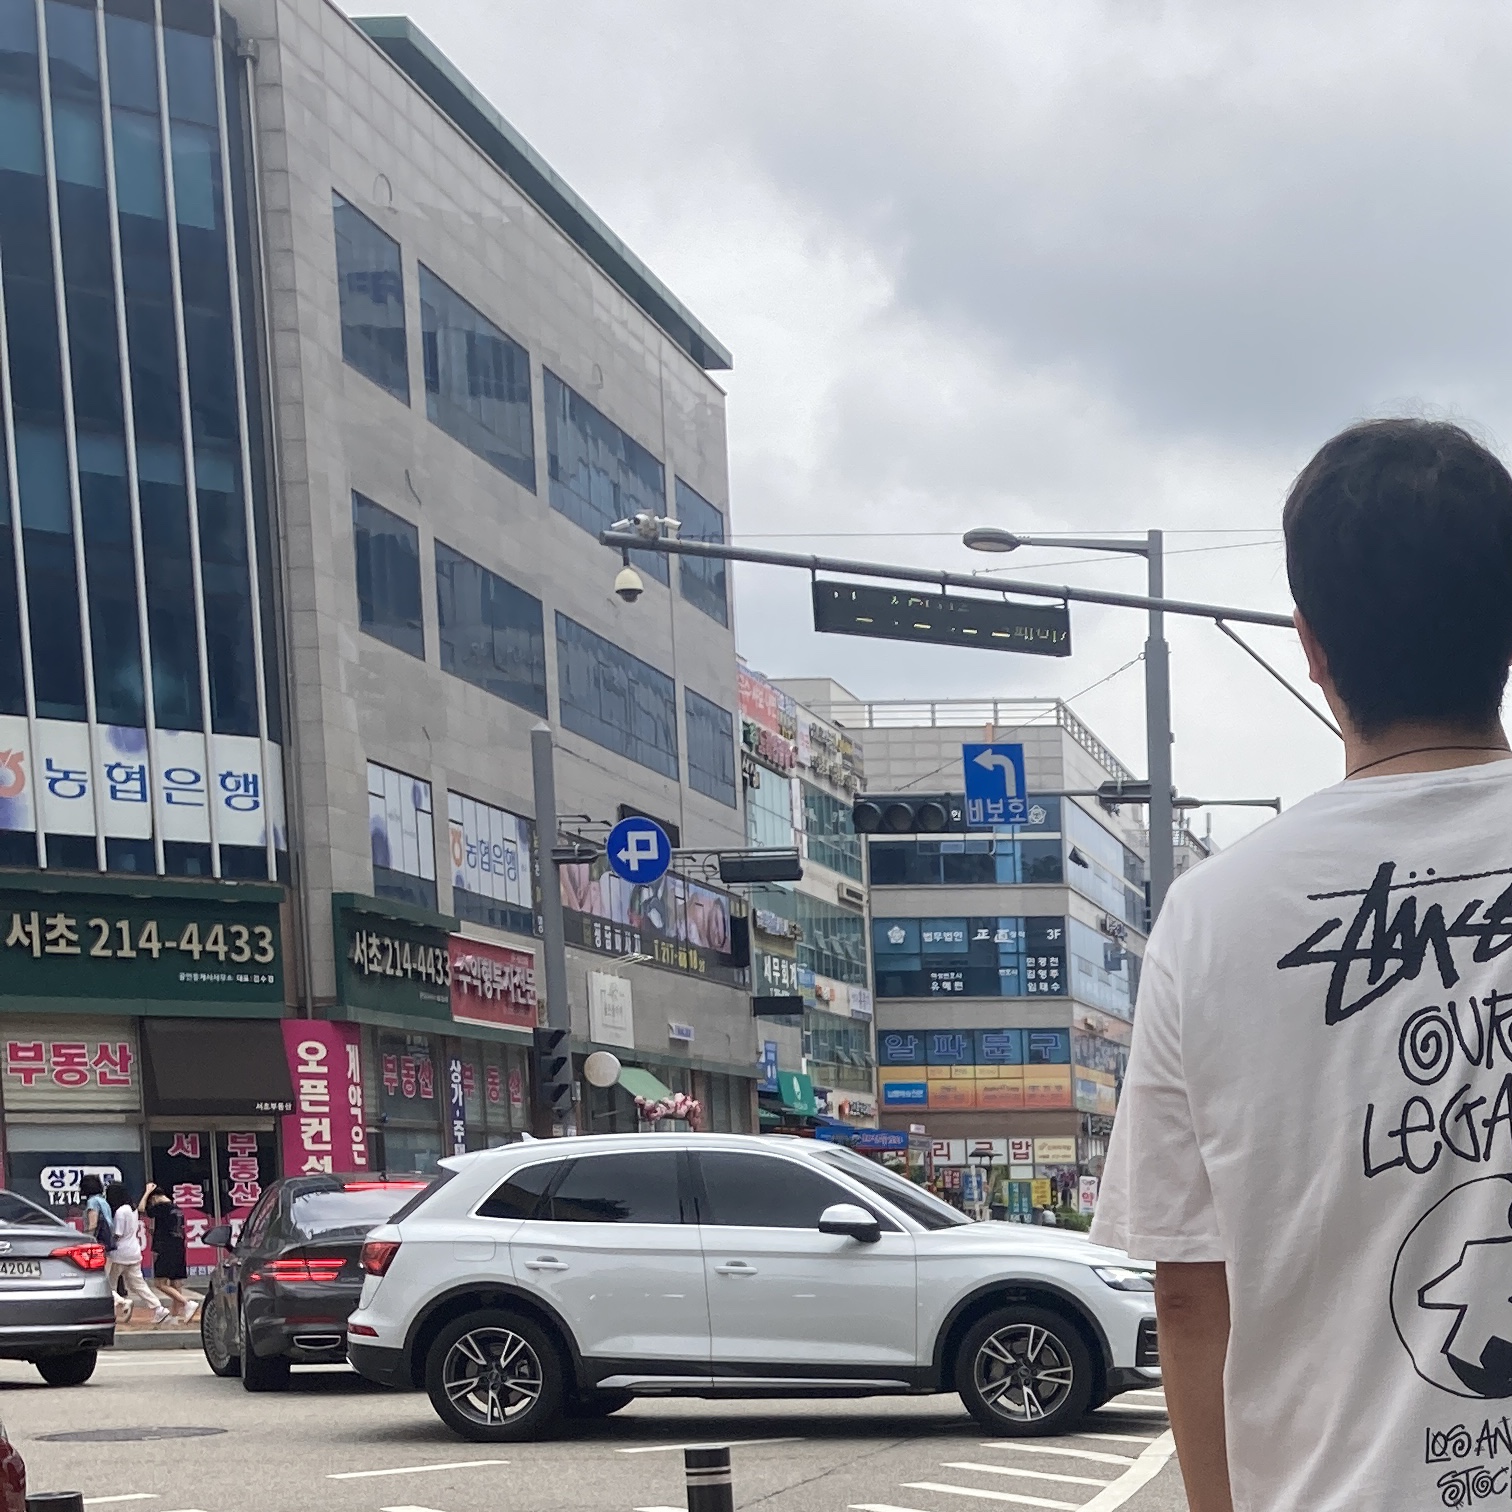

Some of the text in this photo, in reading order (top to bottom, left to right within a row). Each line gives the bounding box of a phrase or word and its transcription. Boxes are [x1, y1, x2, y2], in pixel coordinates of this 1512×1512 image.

[45, 757, 261, 812] 농협은행
[968, 797, 1027, 823] 비보호
[465, 834, 517, 882] 농협은행
[5, 910, 276, 964] 서초 214-4433
[354, 930, 450, 987] 서초 214-4433
[922, 930, 964, 943] 법무법인
[1046, 928, 1062, 941] 3F
[6, 1041, 135, 1088] 부동산
[884, 1033, 1062, 1061] 알파문구
[382, 1053, 435, 1101] 부동산
[460, 1062, 523, 1108] 부동산
[227, 1132, 262, 1207] 부동산
[1425, 1423, 1472, 1464] LOS
